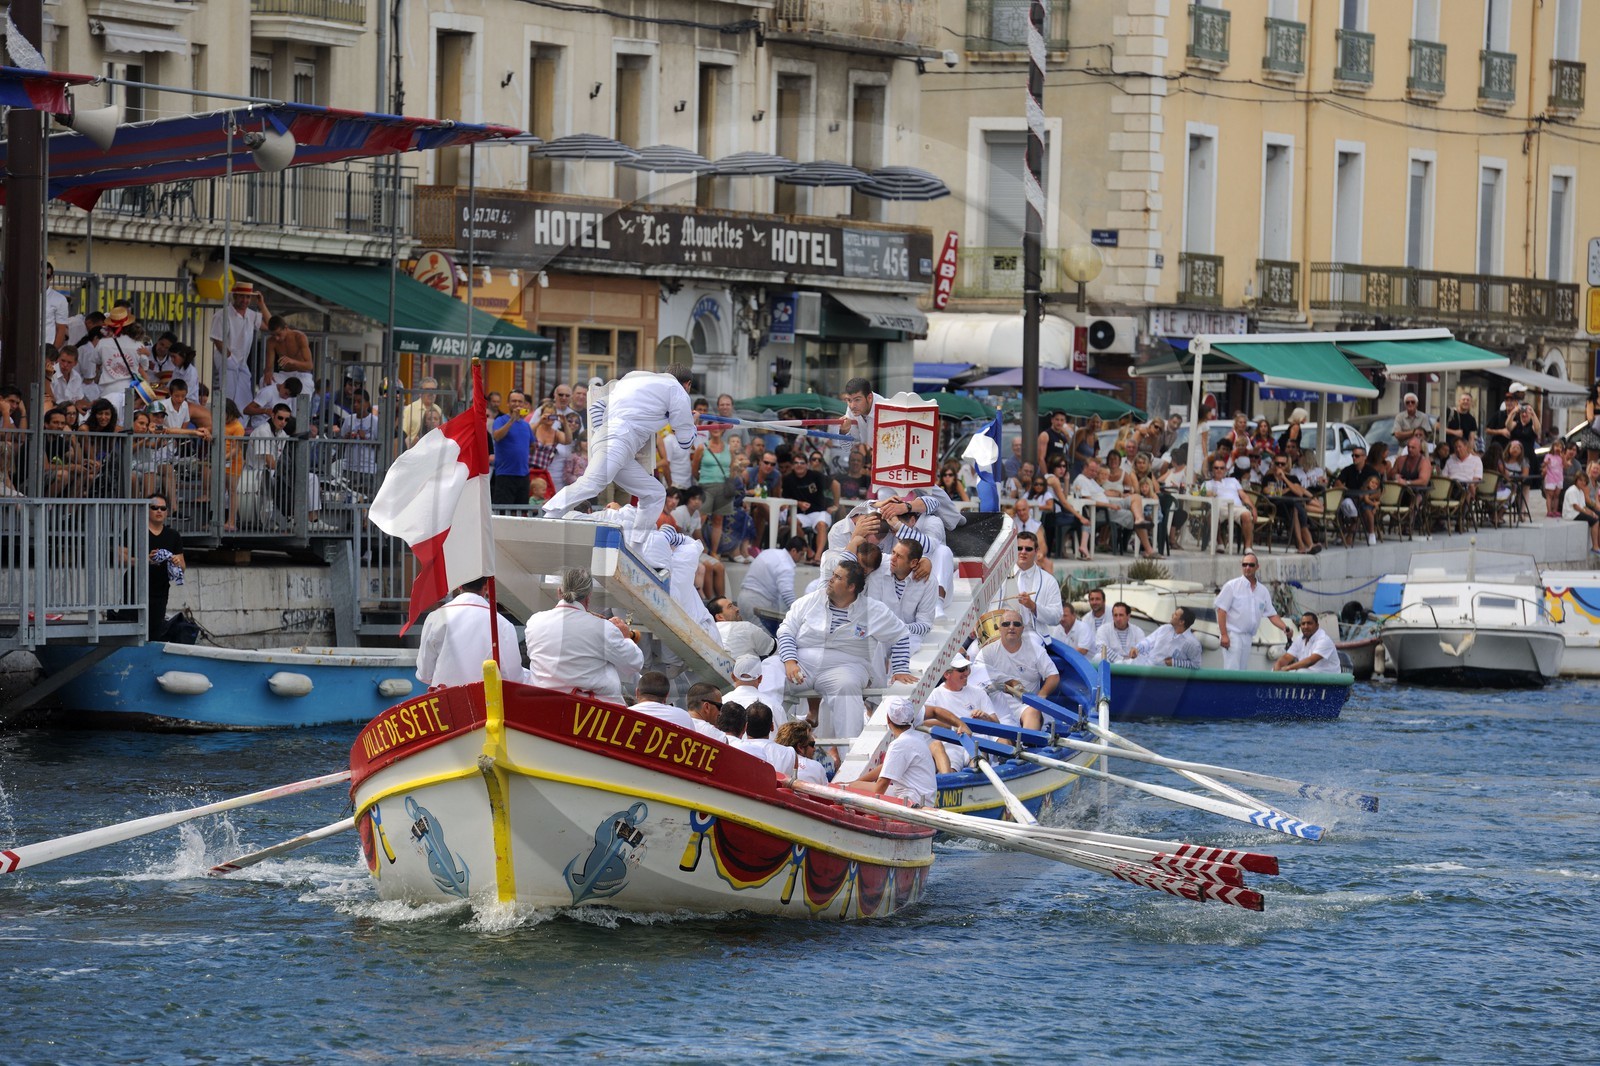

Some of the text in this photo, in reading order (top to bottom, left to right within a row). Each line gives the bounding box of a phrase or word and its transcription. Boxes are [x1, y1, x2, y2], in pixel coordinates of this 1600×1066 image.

[534, 209, 611, 249] HOTEL
[771, 228, 838, 268] HOTEL
[937, 233, 958, 308] TABAC
[1163, 311, 1235, 334] LE JOUTEUR
[485, 341, 515, 360] PUB
[888, 470, 918, 481] SETE
[362, 697, 450, 759] VILLE DE SETE
[572, 702, 720, 773] VILLE DE SETE
